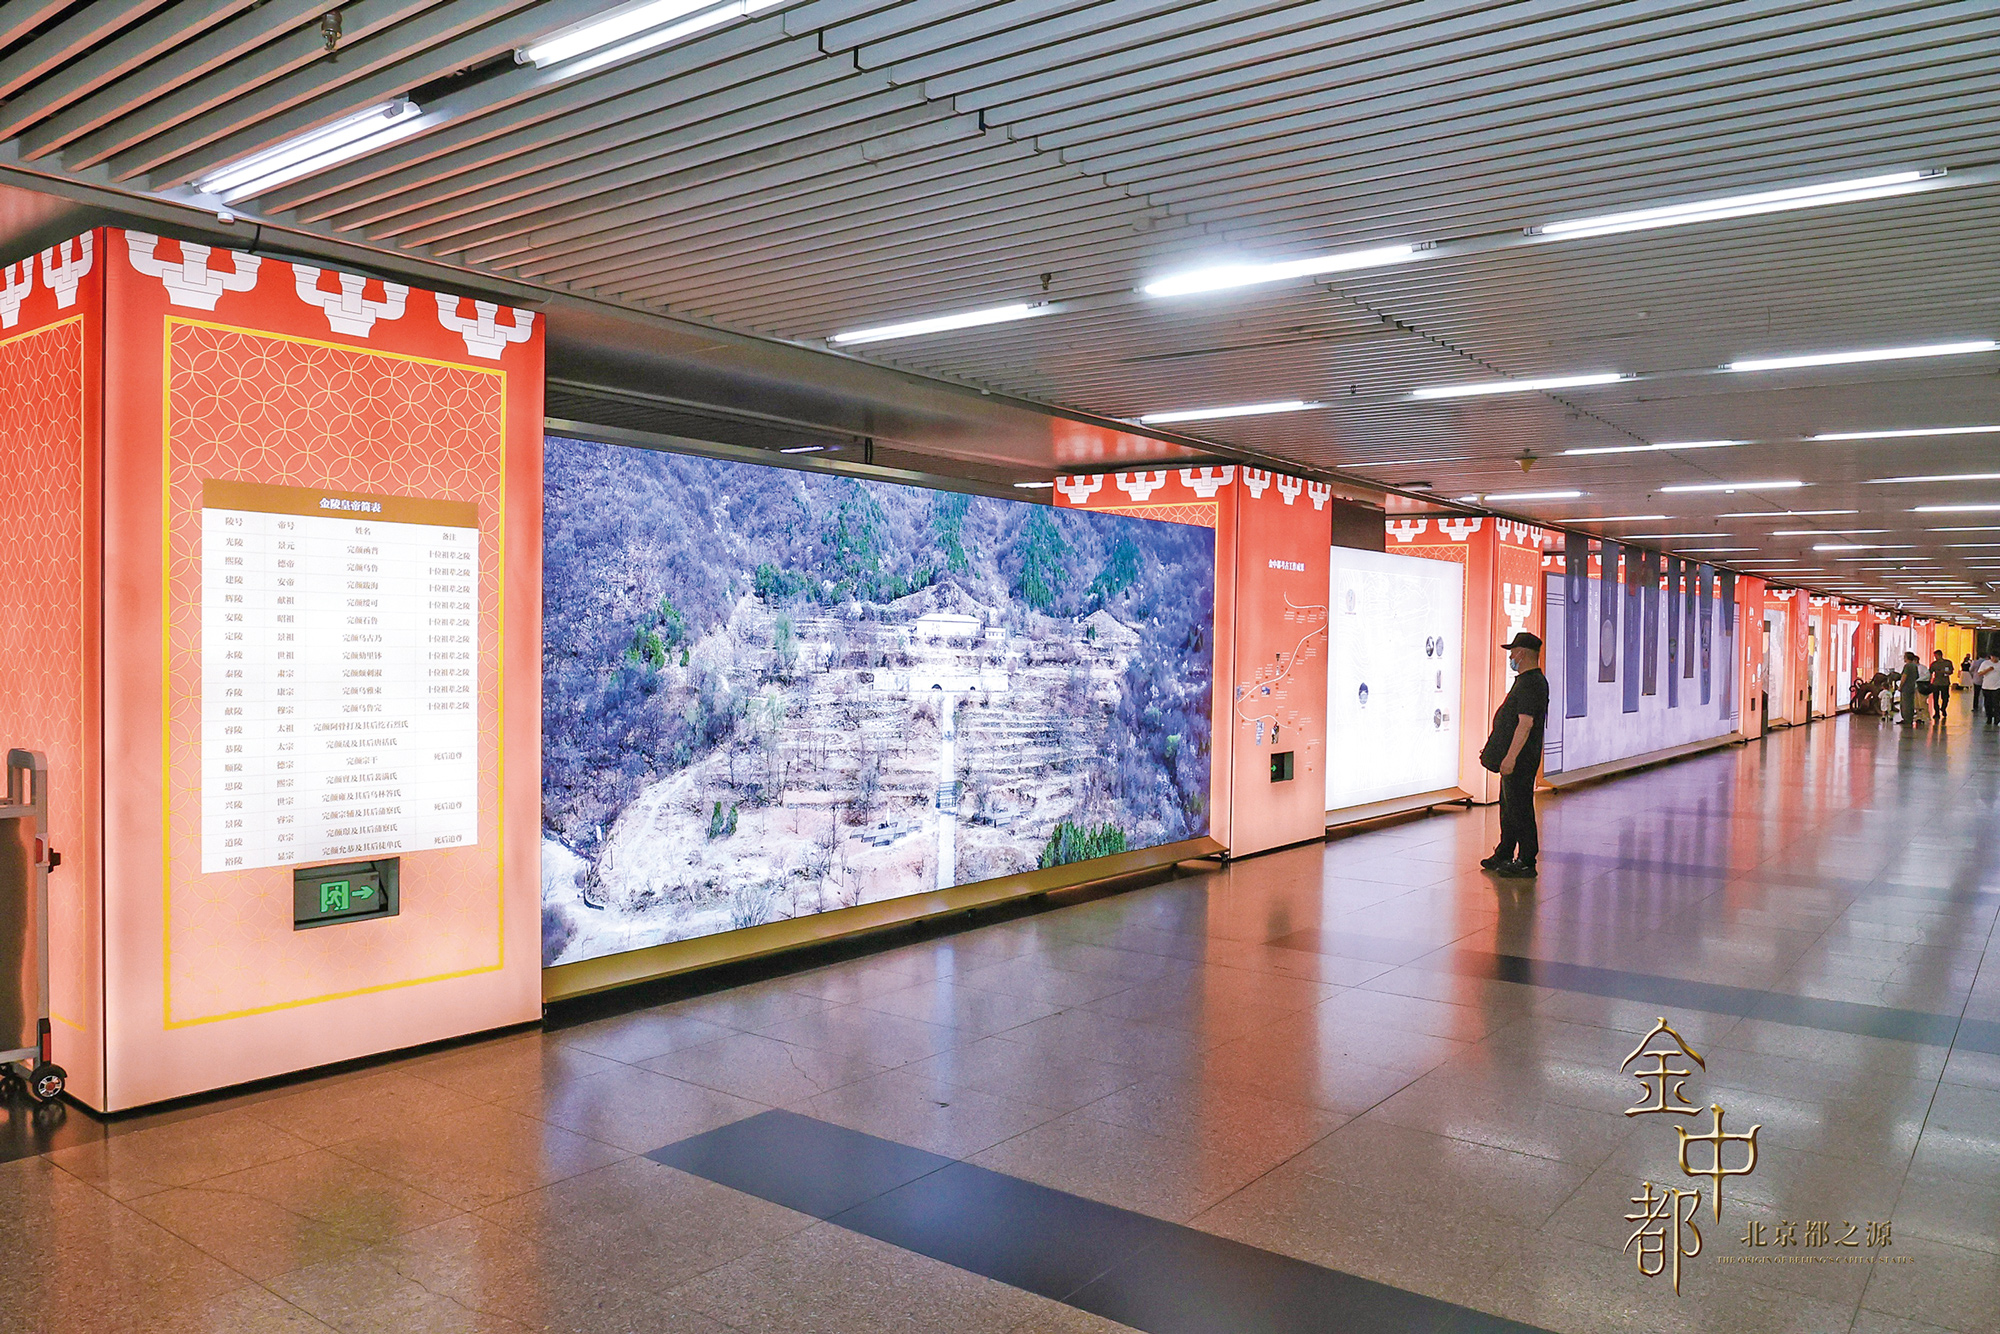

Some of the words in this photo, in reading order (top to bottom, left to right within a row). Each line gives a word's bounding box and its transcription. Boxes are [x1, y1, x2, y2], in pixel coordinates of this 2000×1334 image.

[319, 497, 382, 513] 金陵皇帝简表
